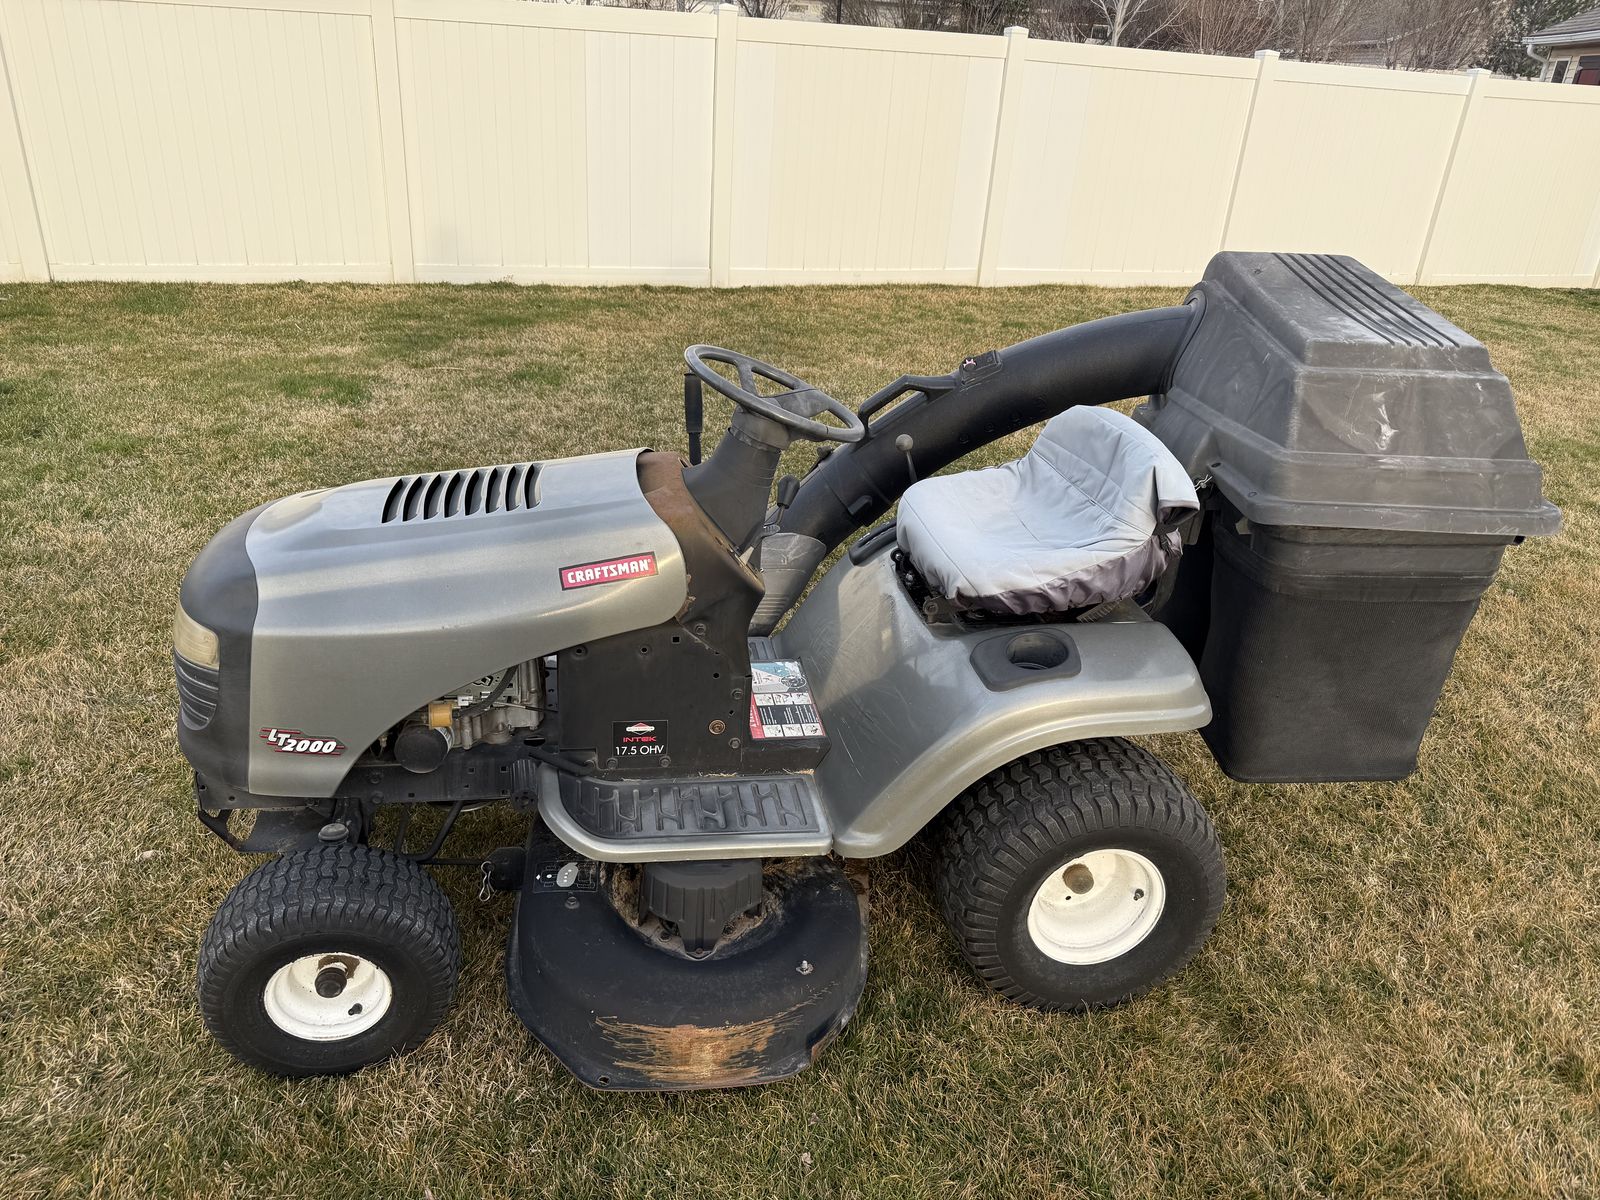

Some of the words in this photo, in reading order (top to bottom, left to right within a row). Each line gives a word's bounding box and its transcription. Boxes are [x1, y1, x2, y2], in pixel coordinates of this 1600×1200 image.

[567, 559, 651, 584] CRAFTSMAN
[615, 745, 637, 756] 17.5
[639, 745, 664, 755] OHV
